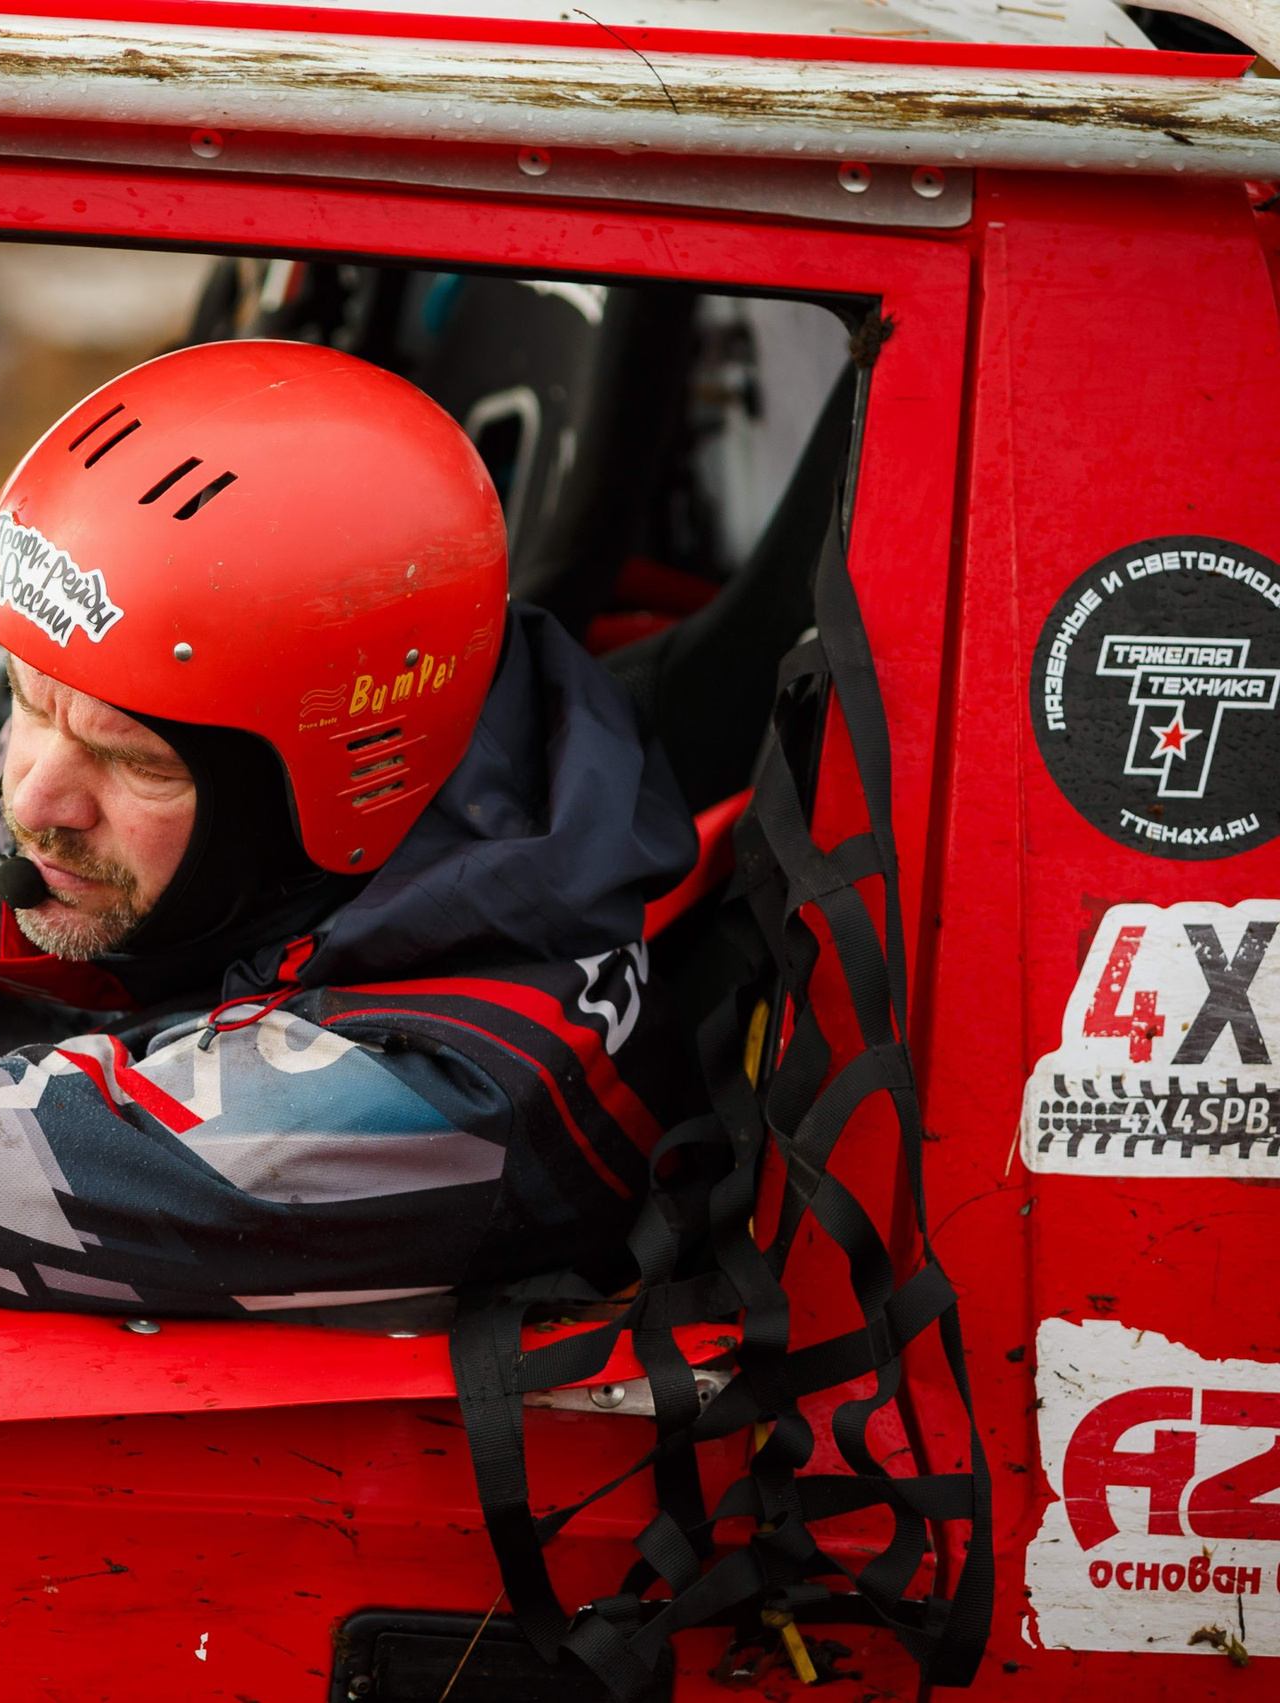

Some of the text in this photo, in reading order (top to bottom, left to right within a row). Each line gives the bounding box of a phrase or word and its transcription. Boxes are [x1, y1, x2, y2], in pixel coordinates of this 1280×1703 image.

[0, 552, 72, 640] России
[1045, 551, 1280, 730] ЛАЗЕРНЫЕ И СВЕТОДИОД
[1148, 676, 1266, 697] ТЕХНИКА
